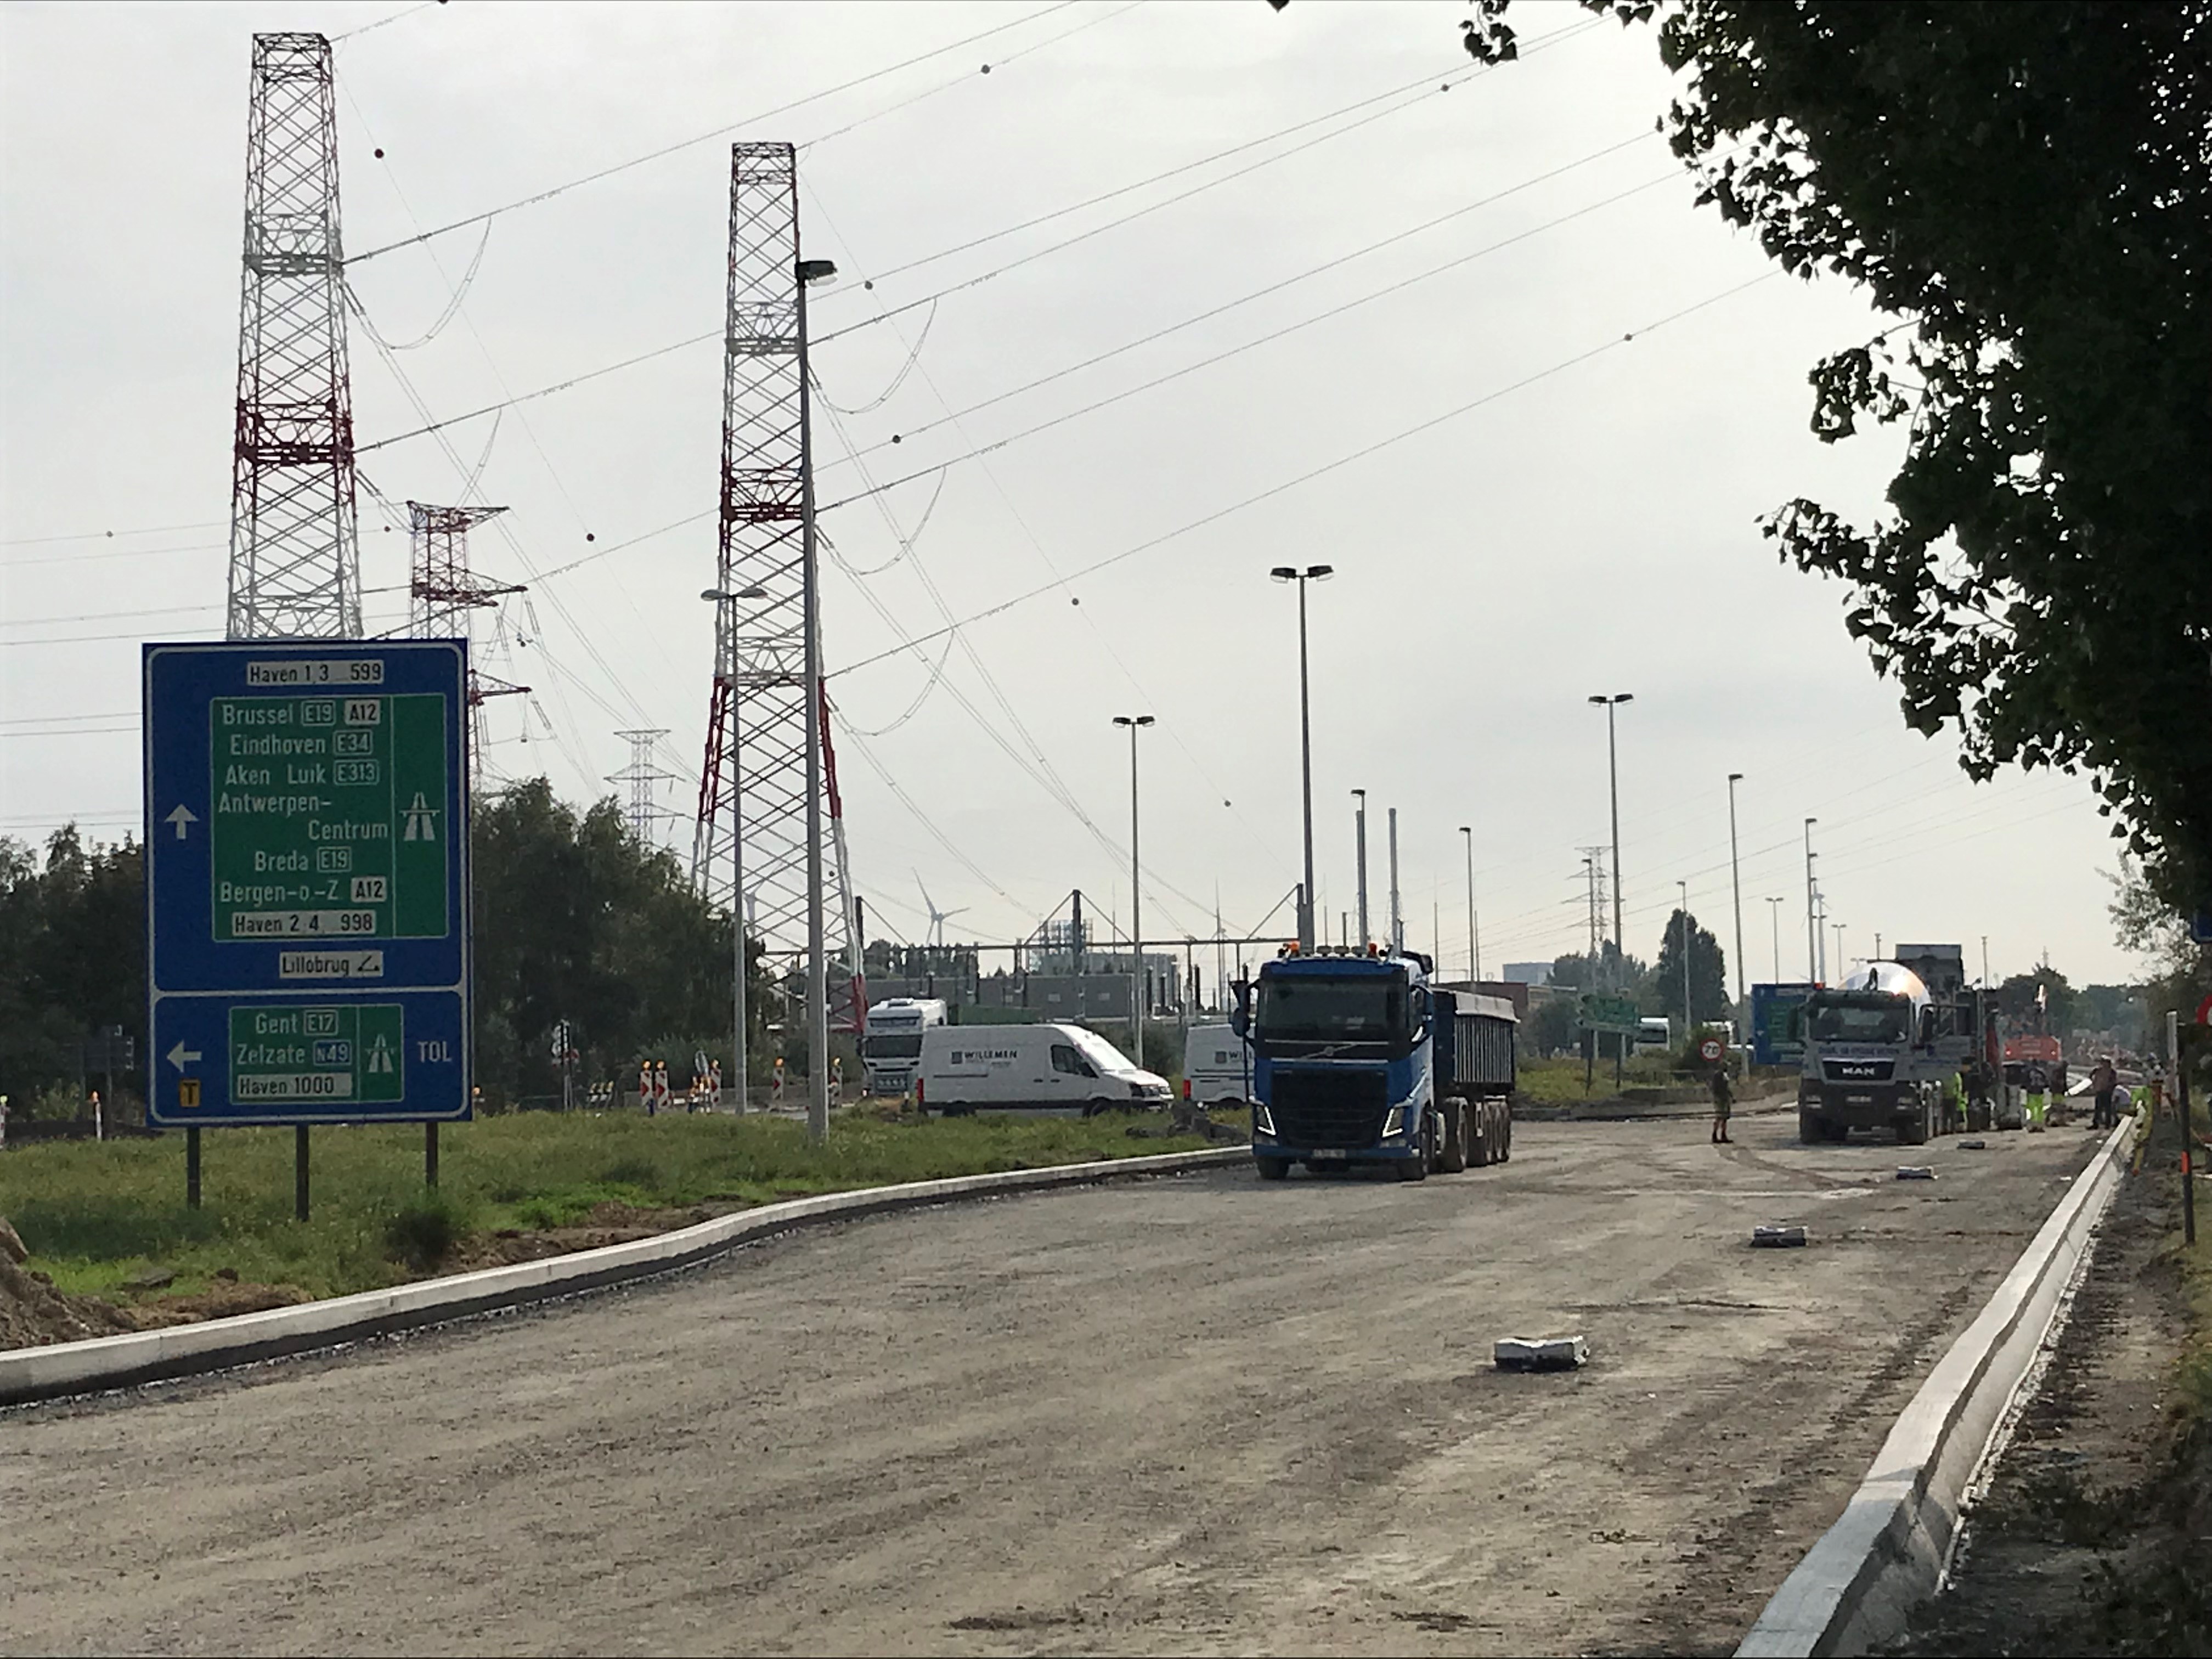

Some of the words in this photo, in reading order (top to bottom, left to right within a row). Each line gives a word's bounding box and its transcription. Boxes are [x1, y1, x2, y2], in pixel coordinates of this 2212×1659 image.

[250, 665, 297, 682] Haven
[351, 663, 381, 681] 599
[222, 704, 293, 725] Brussel
[304, 704, 332, 722] E19
[349, 704, 377, 721] A12
[230, 733, 326, 755] Eindhoven
[337, 733, 369, 752] E34
[225, 764, 270, 785] Aken
[287, 764, 326, 785] Luik
[338, 764, 375, 781] E313
[219, 792, 332, 819] Antwerpen-
[308, 819, 388, 840] Centrum
[255, 850, 309, 871] Breda
[320, 851, 348, 868] E19
[356, 881, 383, 899] A12
[235, 915, 282, 932] Haven
[341, 913, 372, 931] 998
[283, 956, 349, 975] Lillobrug
[256, 1013, 298, 1034] Gent
[308, 1015, 334, 1031] E17
[237, 1044, 305, 1065] Zelzate
[317, 1043, 348, 1062] N49
[417, 1041, 452, 1063] TOL
[964, 1050, 1017, 1059] WILLEMEN
[1842, 1067, 1875, 1075] MAN
[183, 1082, 198, 1105] T
[240, 1078, 287, 1094] Haven
[295, 1076, 334, 1093] 1000
